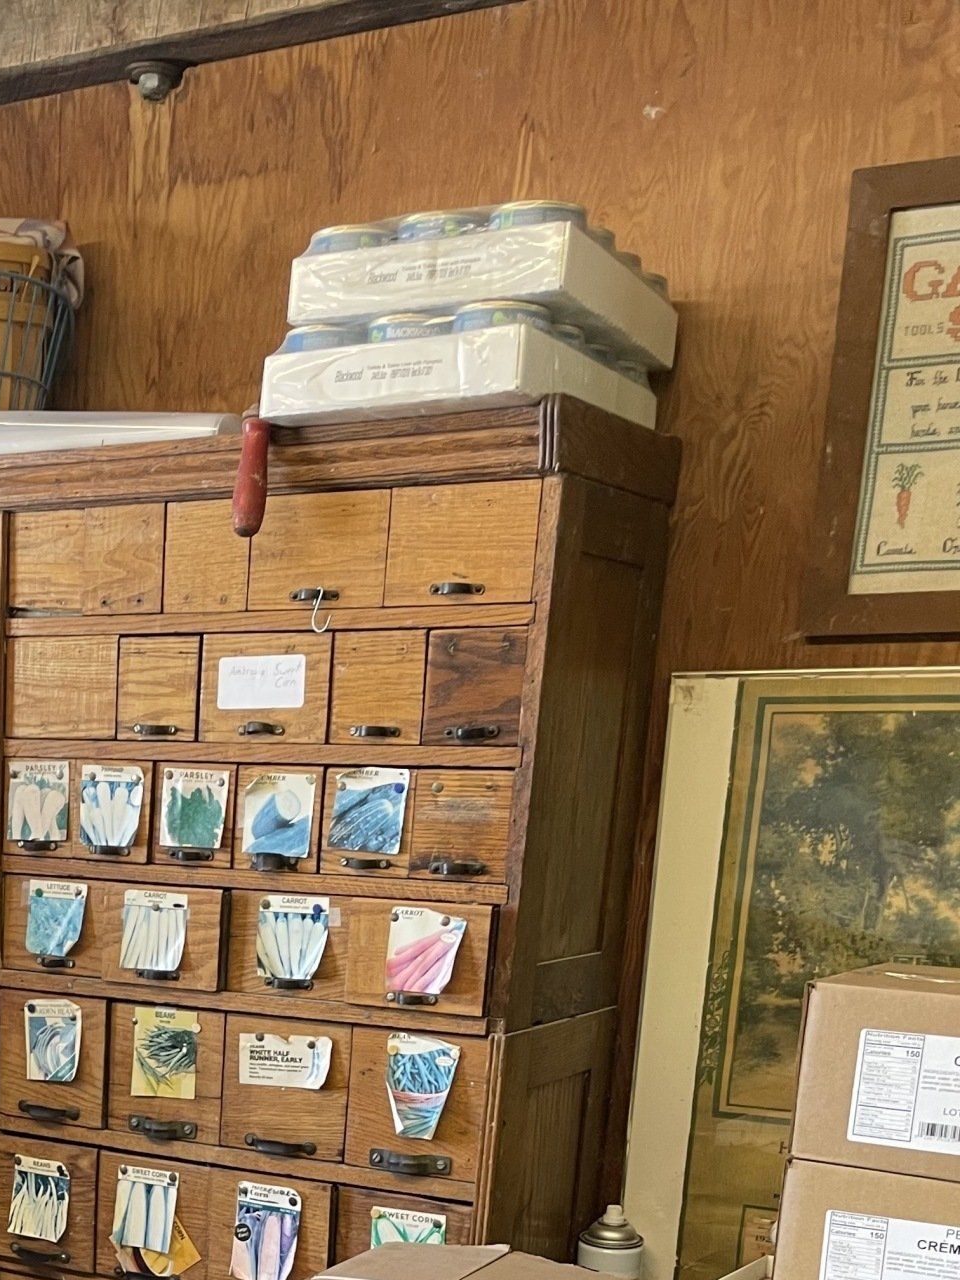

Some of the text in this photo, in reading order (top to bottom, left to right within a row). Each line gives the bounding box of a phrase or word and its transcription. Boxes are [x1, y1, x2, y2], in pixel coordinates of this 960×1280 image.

[25, 764, 56, 772] PARSLEY
[46, 883, 71, 892] LETTUCE
[144, 891, 167, 899] CARROT
[281, 897, 308, 905] CARROT
[154, 1011, 176, 1020] BEANS
[905, 1050, 920, 1058] 150
[32, 1160, 51, 1169] BEANS
[132, 1167, 168, 1179] SWEET CORN
[250, 1190, 269, 1198] Corn
[173, 1220, 186, 1241] CORN
[870, 1231, 885, 1239] 150
